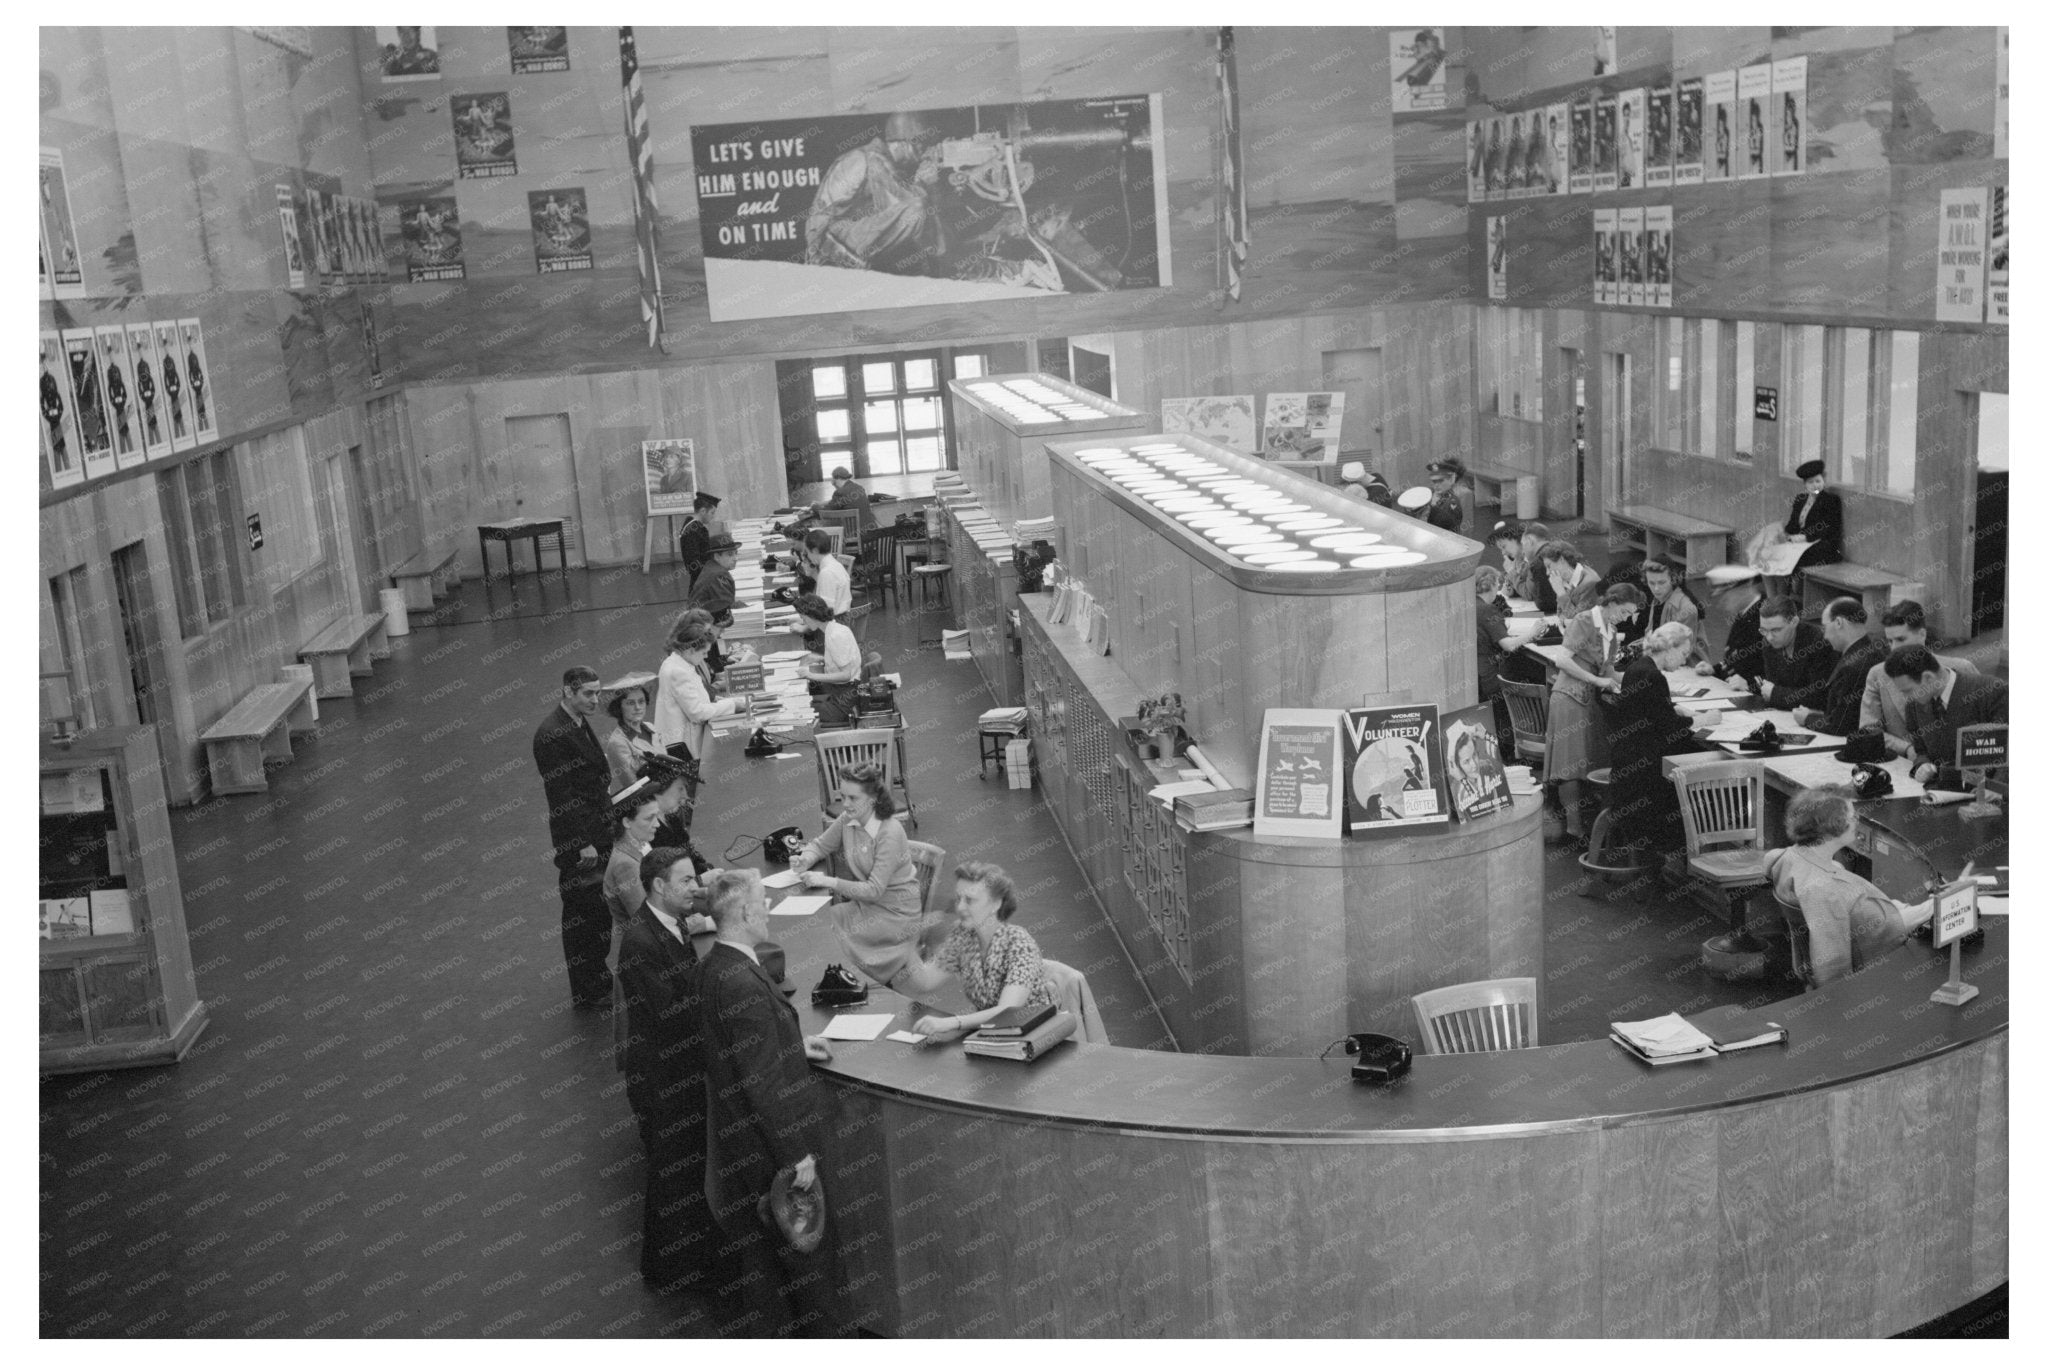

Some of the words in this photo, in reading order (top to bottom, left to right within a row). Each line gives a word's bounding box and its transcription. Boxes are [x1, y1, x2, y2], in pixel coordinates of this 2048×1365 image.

[710, 142, 753, 162] LET'S
[760, 138, 804, 158] GIVE
[699, 174, 736, 194] HIM
[742, 167, 820, 190] ENOUGH
[737, 192, 780, 216] and
[719, 226, 746, 245] ON
[752, 222, 797, 242] TIME
[1966, 746, 2004, 756] HOUSING
[1406, 800, 1436, 811] PLOTTER
[1942, 904, 1971, 922] NFORMATION
[1945, 917, 1965, 931] CENTER
